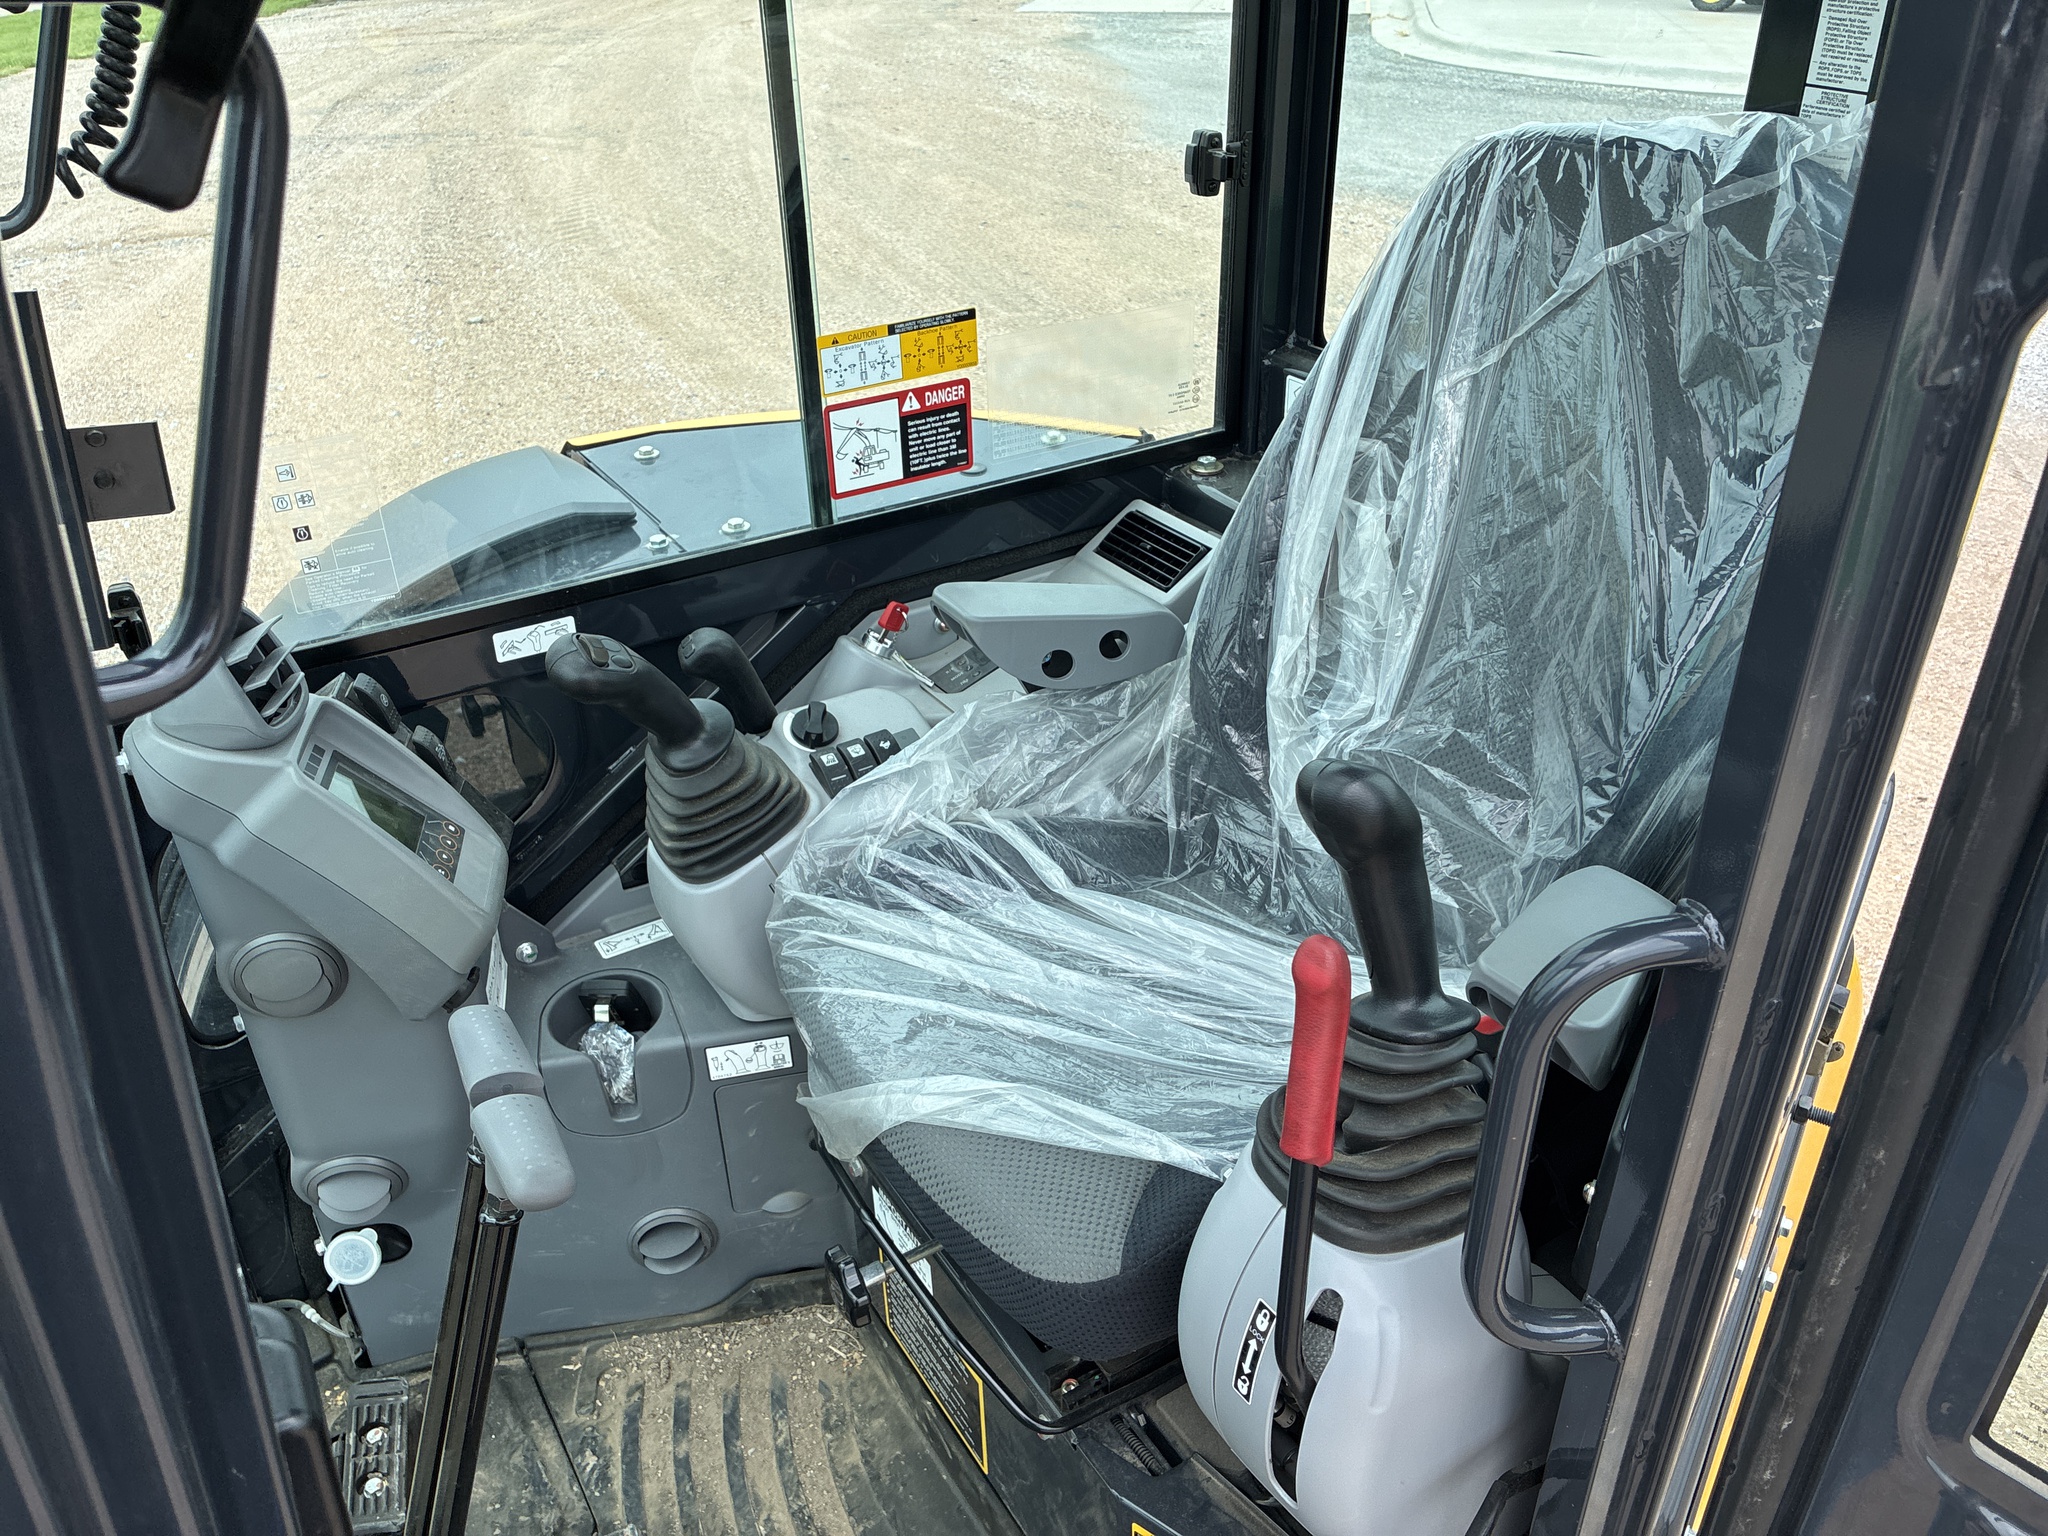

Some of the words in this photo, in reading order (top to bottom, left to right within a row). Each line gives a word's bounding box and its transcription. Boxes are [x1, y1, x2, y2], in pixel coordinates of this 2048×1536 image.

[1821, 91, 1848, 99] PROTECTIVE
[1816, 100, 1850, 108] CERTIFICATION
[918, 328, 938, 336] Backhoe
[940, 324, 958, 332] Pattern
[848, 330, 878, 342] CAUTION
[835, 342, 862, 352] Excavator
[864, 338, 884, 346] Pattern
[925, 385, 965, 406] DANGER
[908, 418, 926, 426] Serious
[926, 414, 940, 424] injury
[943, 418, 960, 426] contact
[920, 428, 937, 437] electric
[910, 450, 927, 459] electric
[910, 462, 930, 472] insulator
[1249, 1325, 1265, 1345] LOCK
